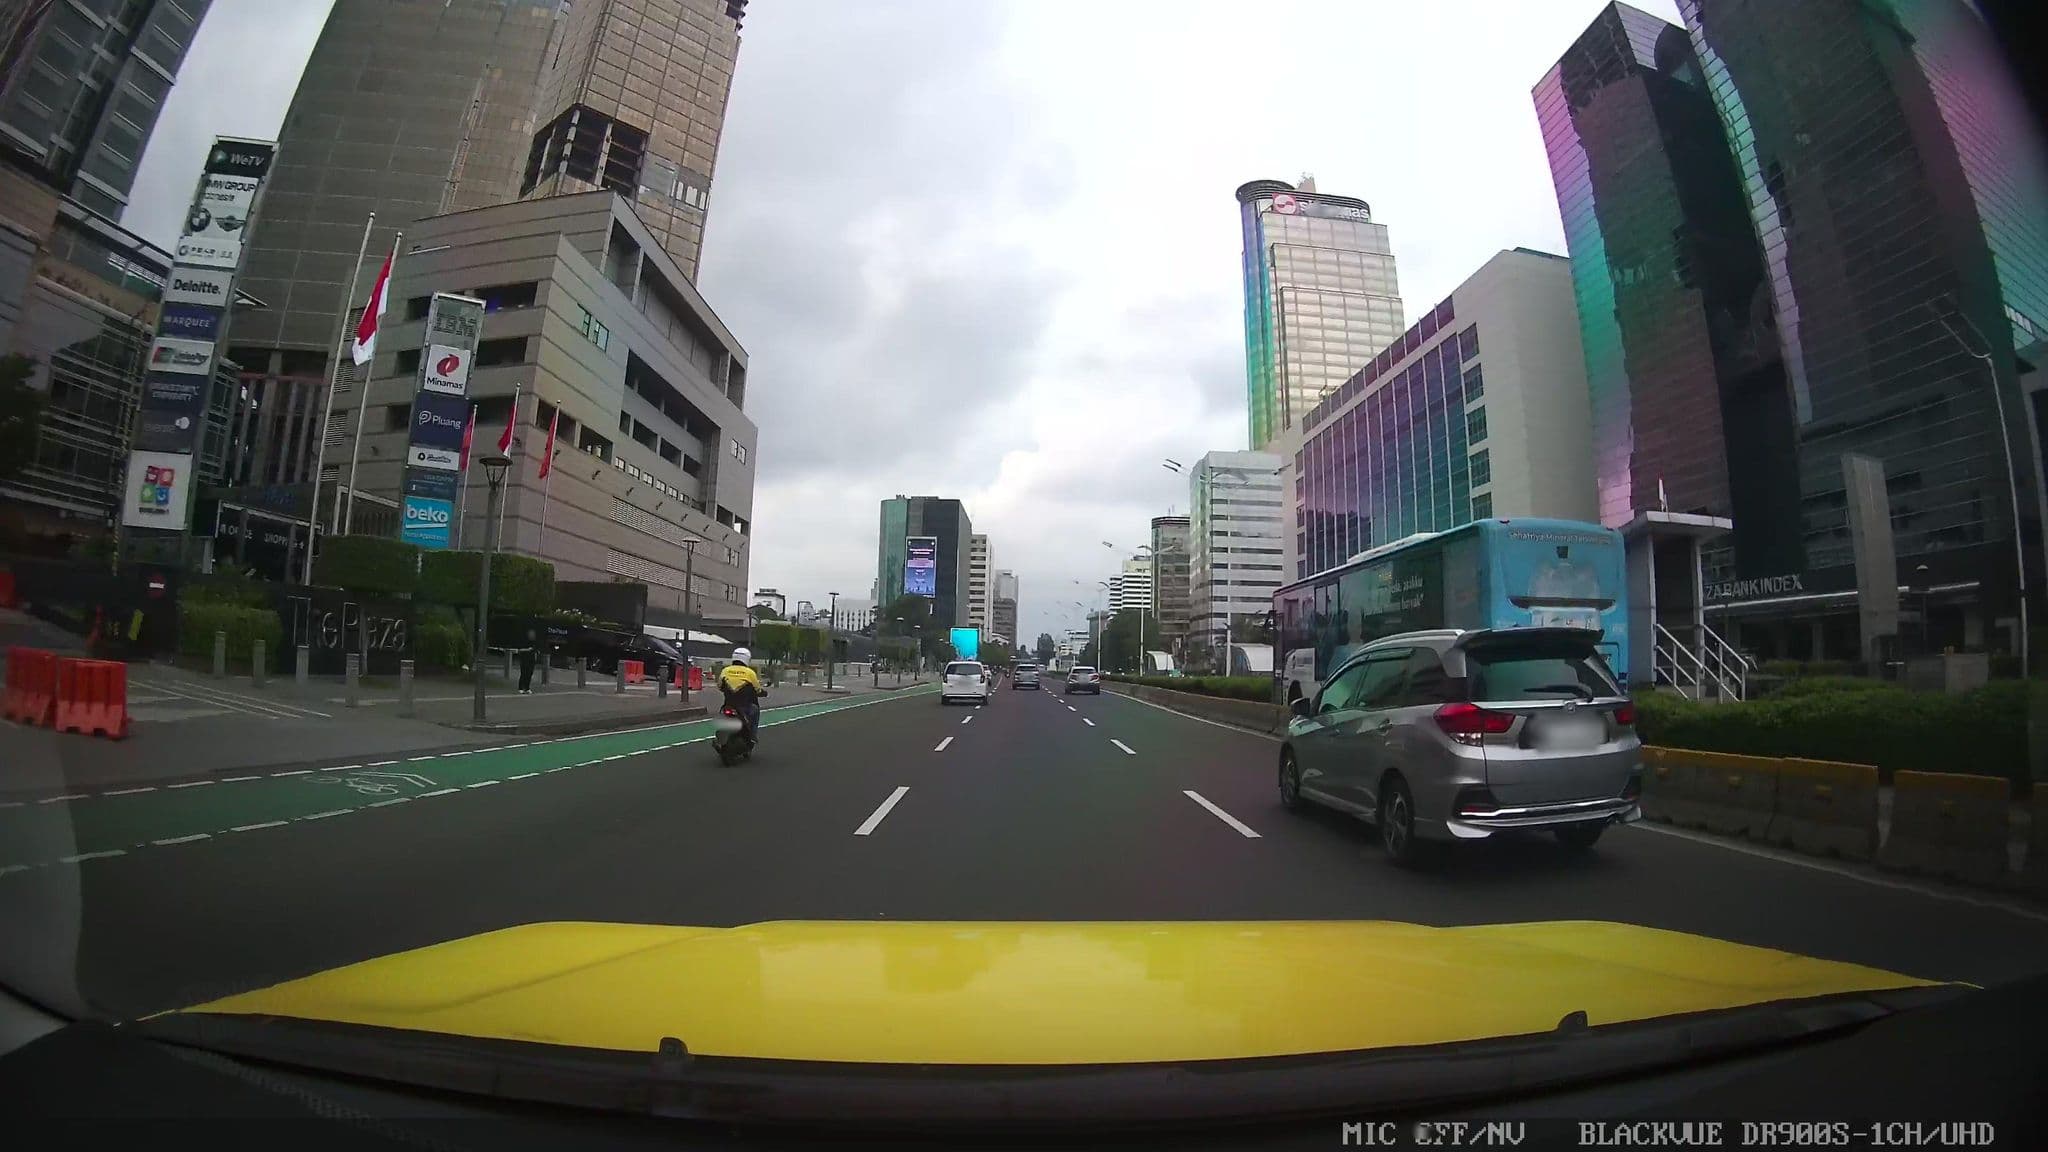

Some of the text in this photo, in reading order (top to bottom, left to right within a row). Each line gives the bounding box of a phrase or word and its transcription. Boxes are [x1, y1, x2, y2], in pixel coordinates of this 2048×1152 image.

[230, 153, 264, 166] WeTV
[225, 181, 257, 192] GROUP
[427, 377, 463, 389] Minamas
[432, 415, 462, 430] Pluang
[406, 503, 449, 523] beko
